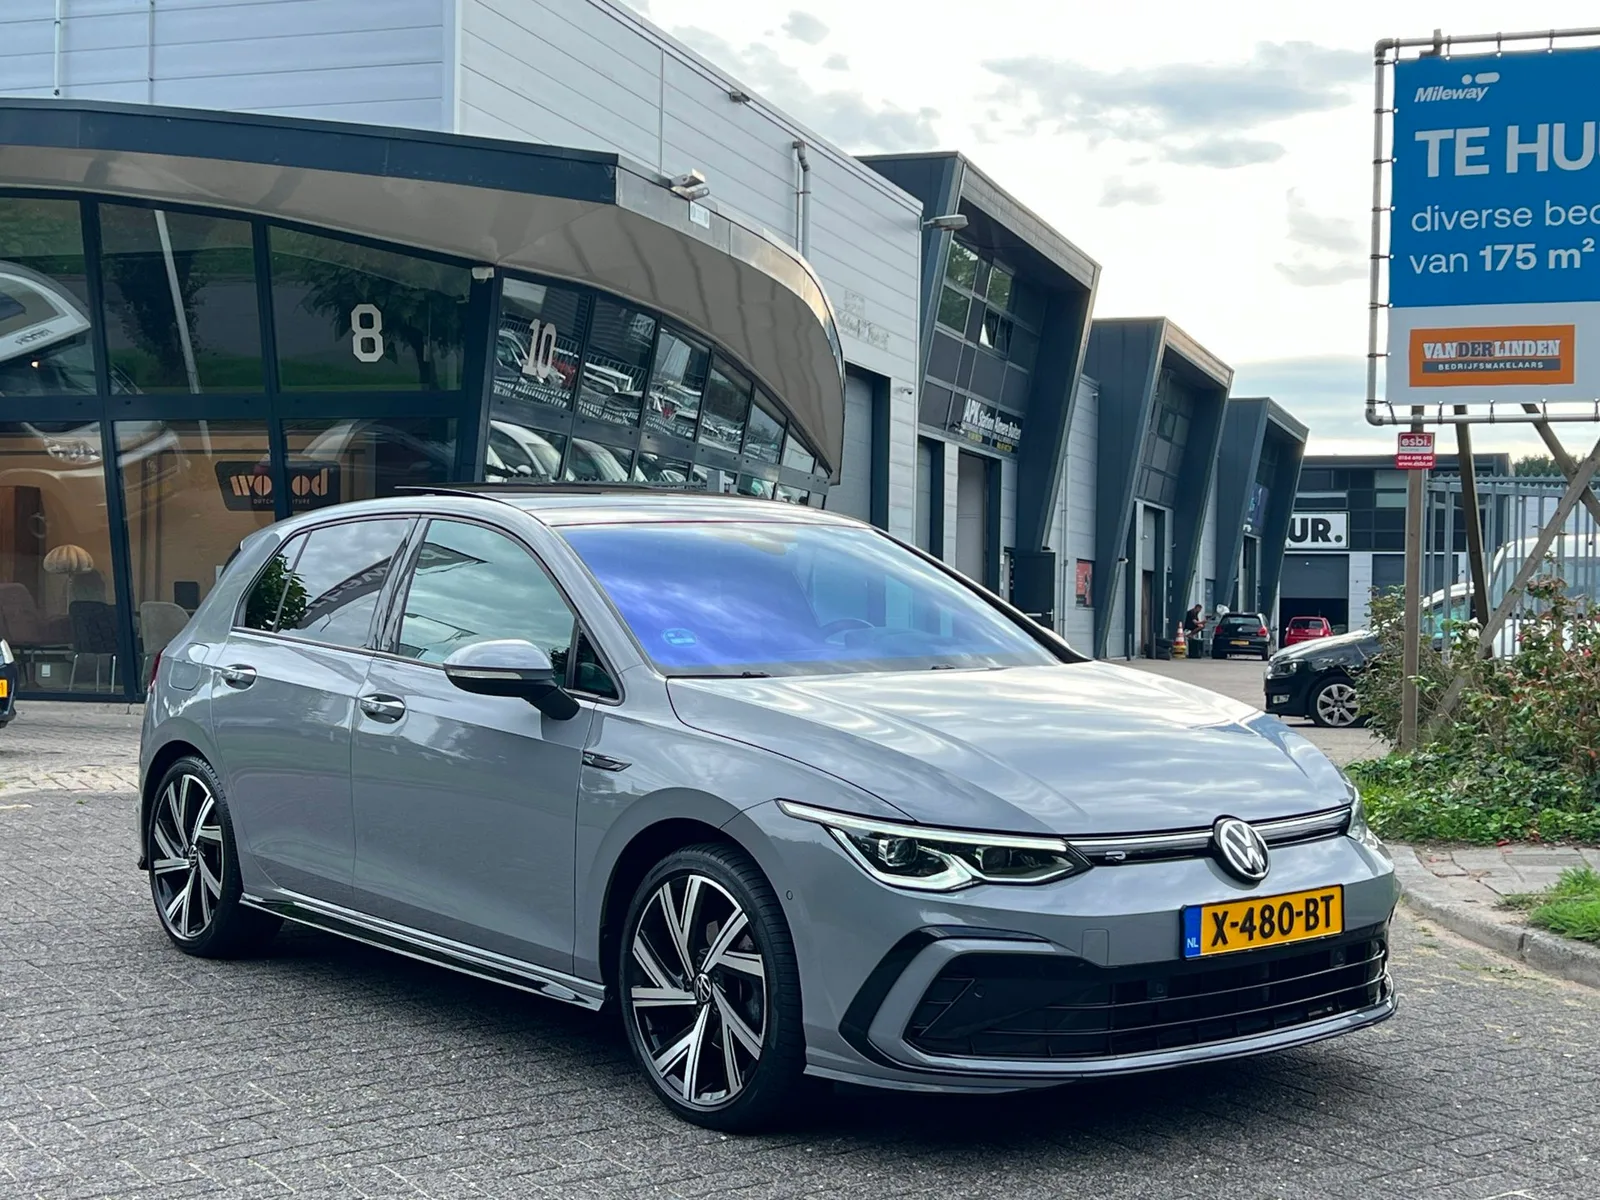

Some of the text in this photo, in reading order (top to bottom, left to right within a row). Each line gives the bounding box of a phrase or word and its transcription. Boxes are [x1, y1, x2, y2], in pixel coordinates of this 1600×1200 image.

[1414, 86, 1489, 103] Mileway
[1415, 121, 1600, 178] TE HU
[1411, 204, 1533, 232] diverse
[1409, 251, 1469, 275] van
[1479, 243, 1537, 272] 175
[350, 303, 384, 363] 8
[522, 318, 557, 379] 10
[1438, 361, 1544, 371] BEDRIJFSMAKELAARS
[1187, 894, 1335, 948] NL X-480-BT
